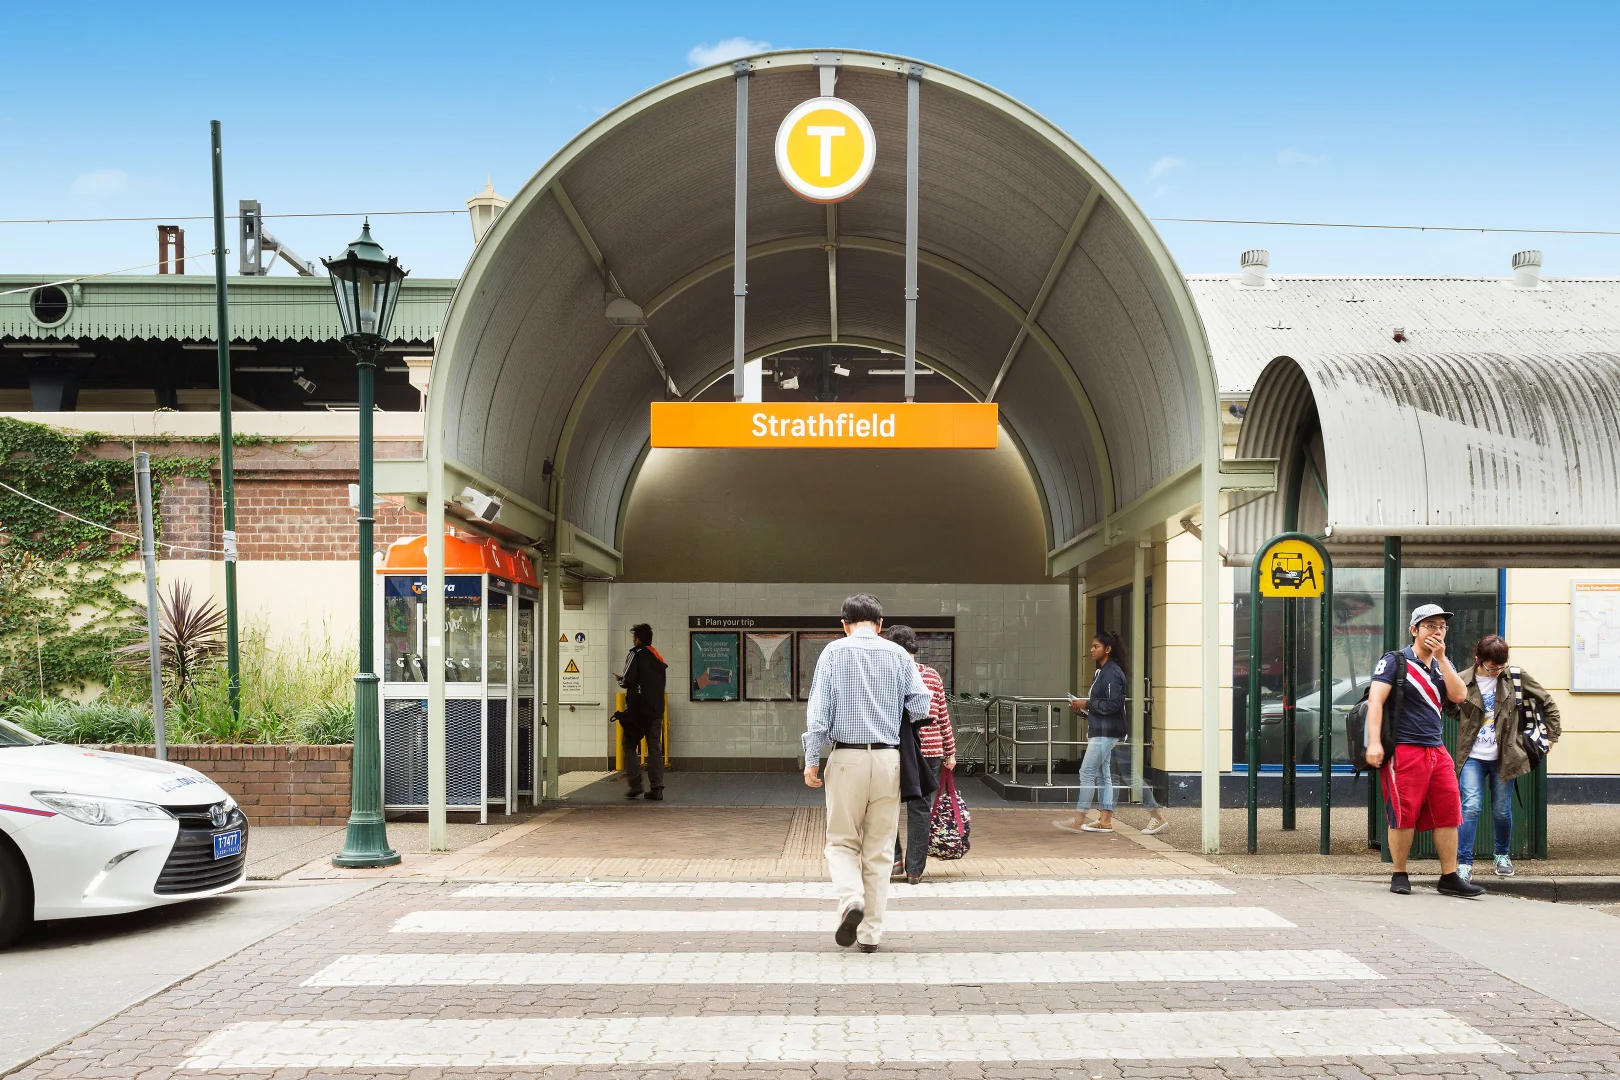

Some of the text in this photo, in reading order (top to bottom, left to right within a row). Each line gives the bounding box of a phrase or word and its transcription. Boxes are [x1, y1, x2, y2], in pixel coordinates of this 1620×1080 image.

[807, 125, 846, 177] T
[751, 412, 896, 438] Strathfield
[705, 618, 722, 626] Plan
[722, 619, 740, 628] your
[741, 618, 755, 628] trip
